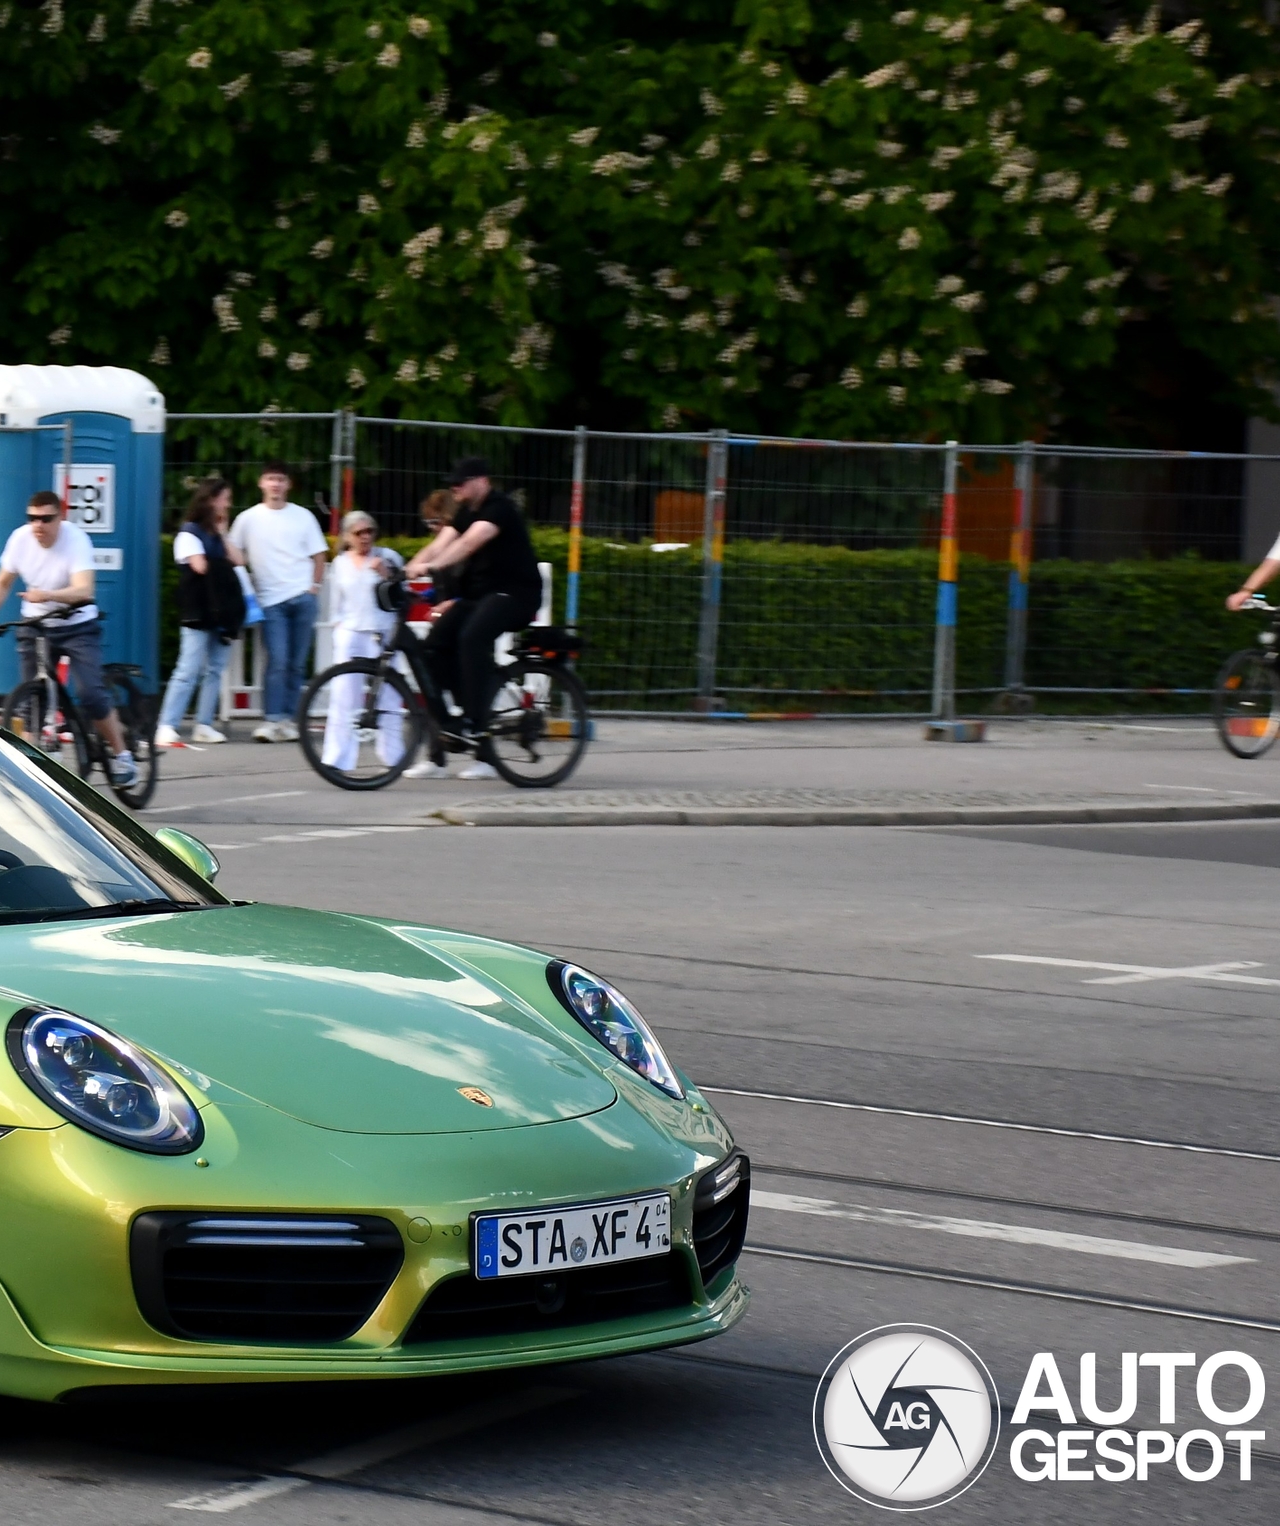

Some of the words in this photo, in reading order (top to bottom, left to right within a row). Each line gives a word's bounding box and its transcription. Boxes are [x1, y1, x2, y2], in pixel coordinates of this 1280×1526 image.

[656, 1203, 668, 1217] 04
[501, 1218, 568, 1268] STA
[592, 1209, 629, 1258] XF
[635, 1205, 651, 1250] 4
